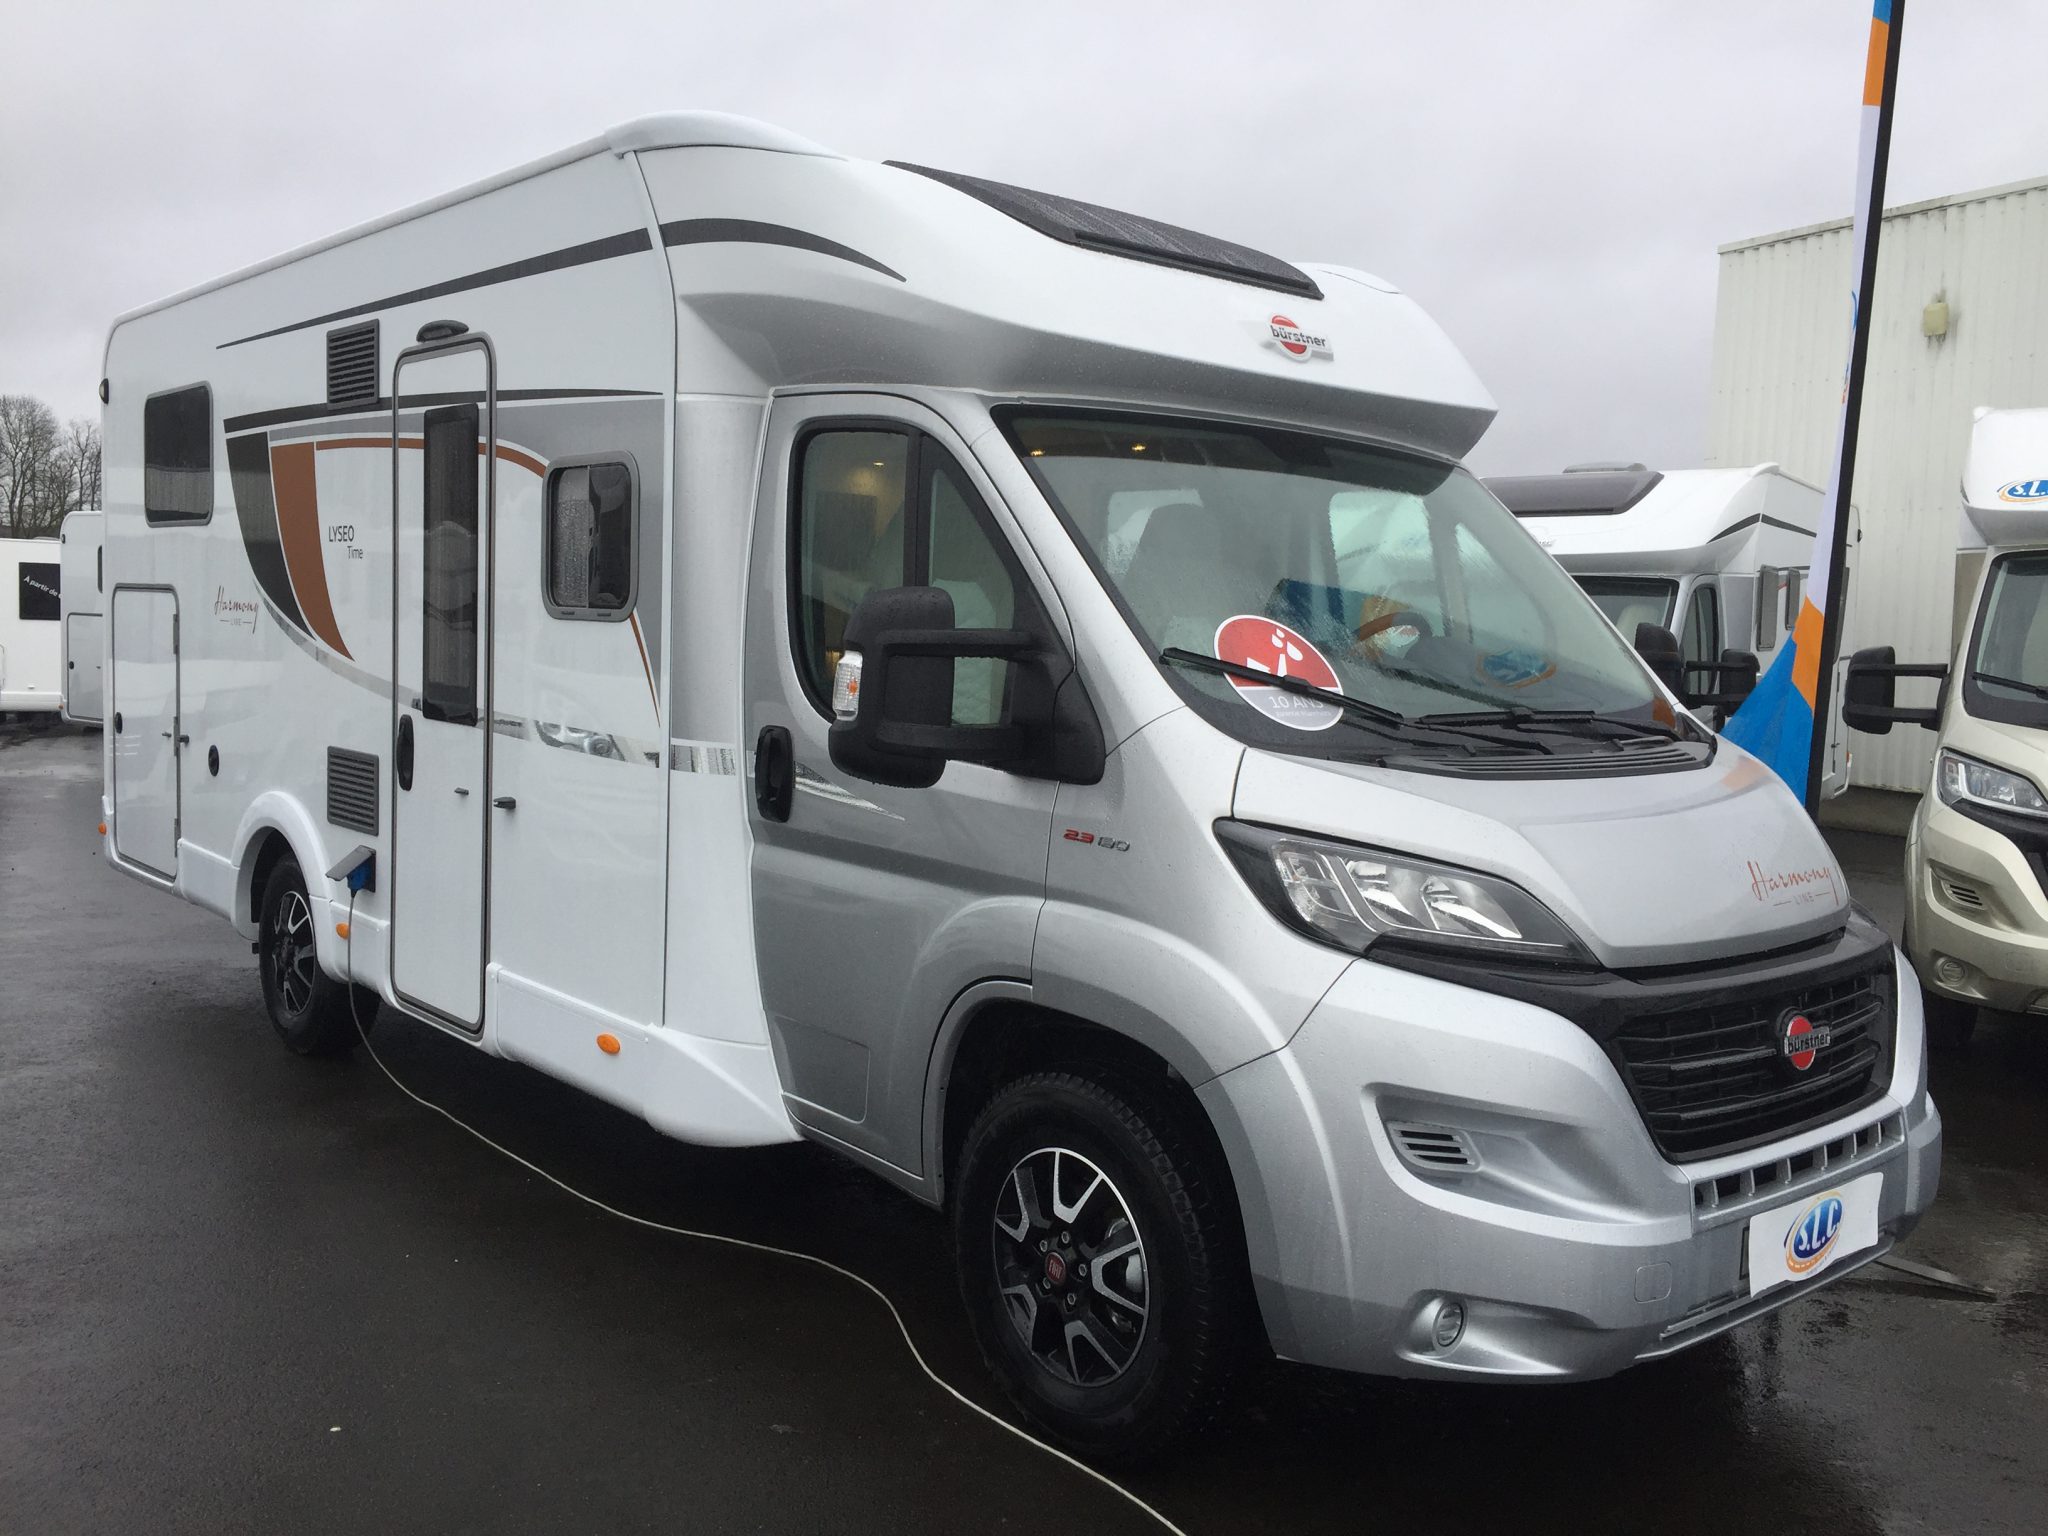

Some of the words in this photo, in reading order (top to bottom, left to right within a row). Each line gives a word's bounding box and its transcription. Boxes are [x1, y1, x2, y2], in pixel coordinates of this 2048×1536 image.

[1270, 324, 1327, 347] bürstner
[2012, 480, 2048, 496] S.L.
[328, 525, 355, 543] LYSEO
[347, 545, 363, 559] Time
[29, 580, 50, 592] partir
[48, 588, 58, 597] de
[214, 585, 258, 634] Harmony
[1268, 695, 1290, 709] 10
[1747, 860, 1839, 906] Harmony
[1786, 1031, 1830, 1055] bürstner
